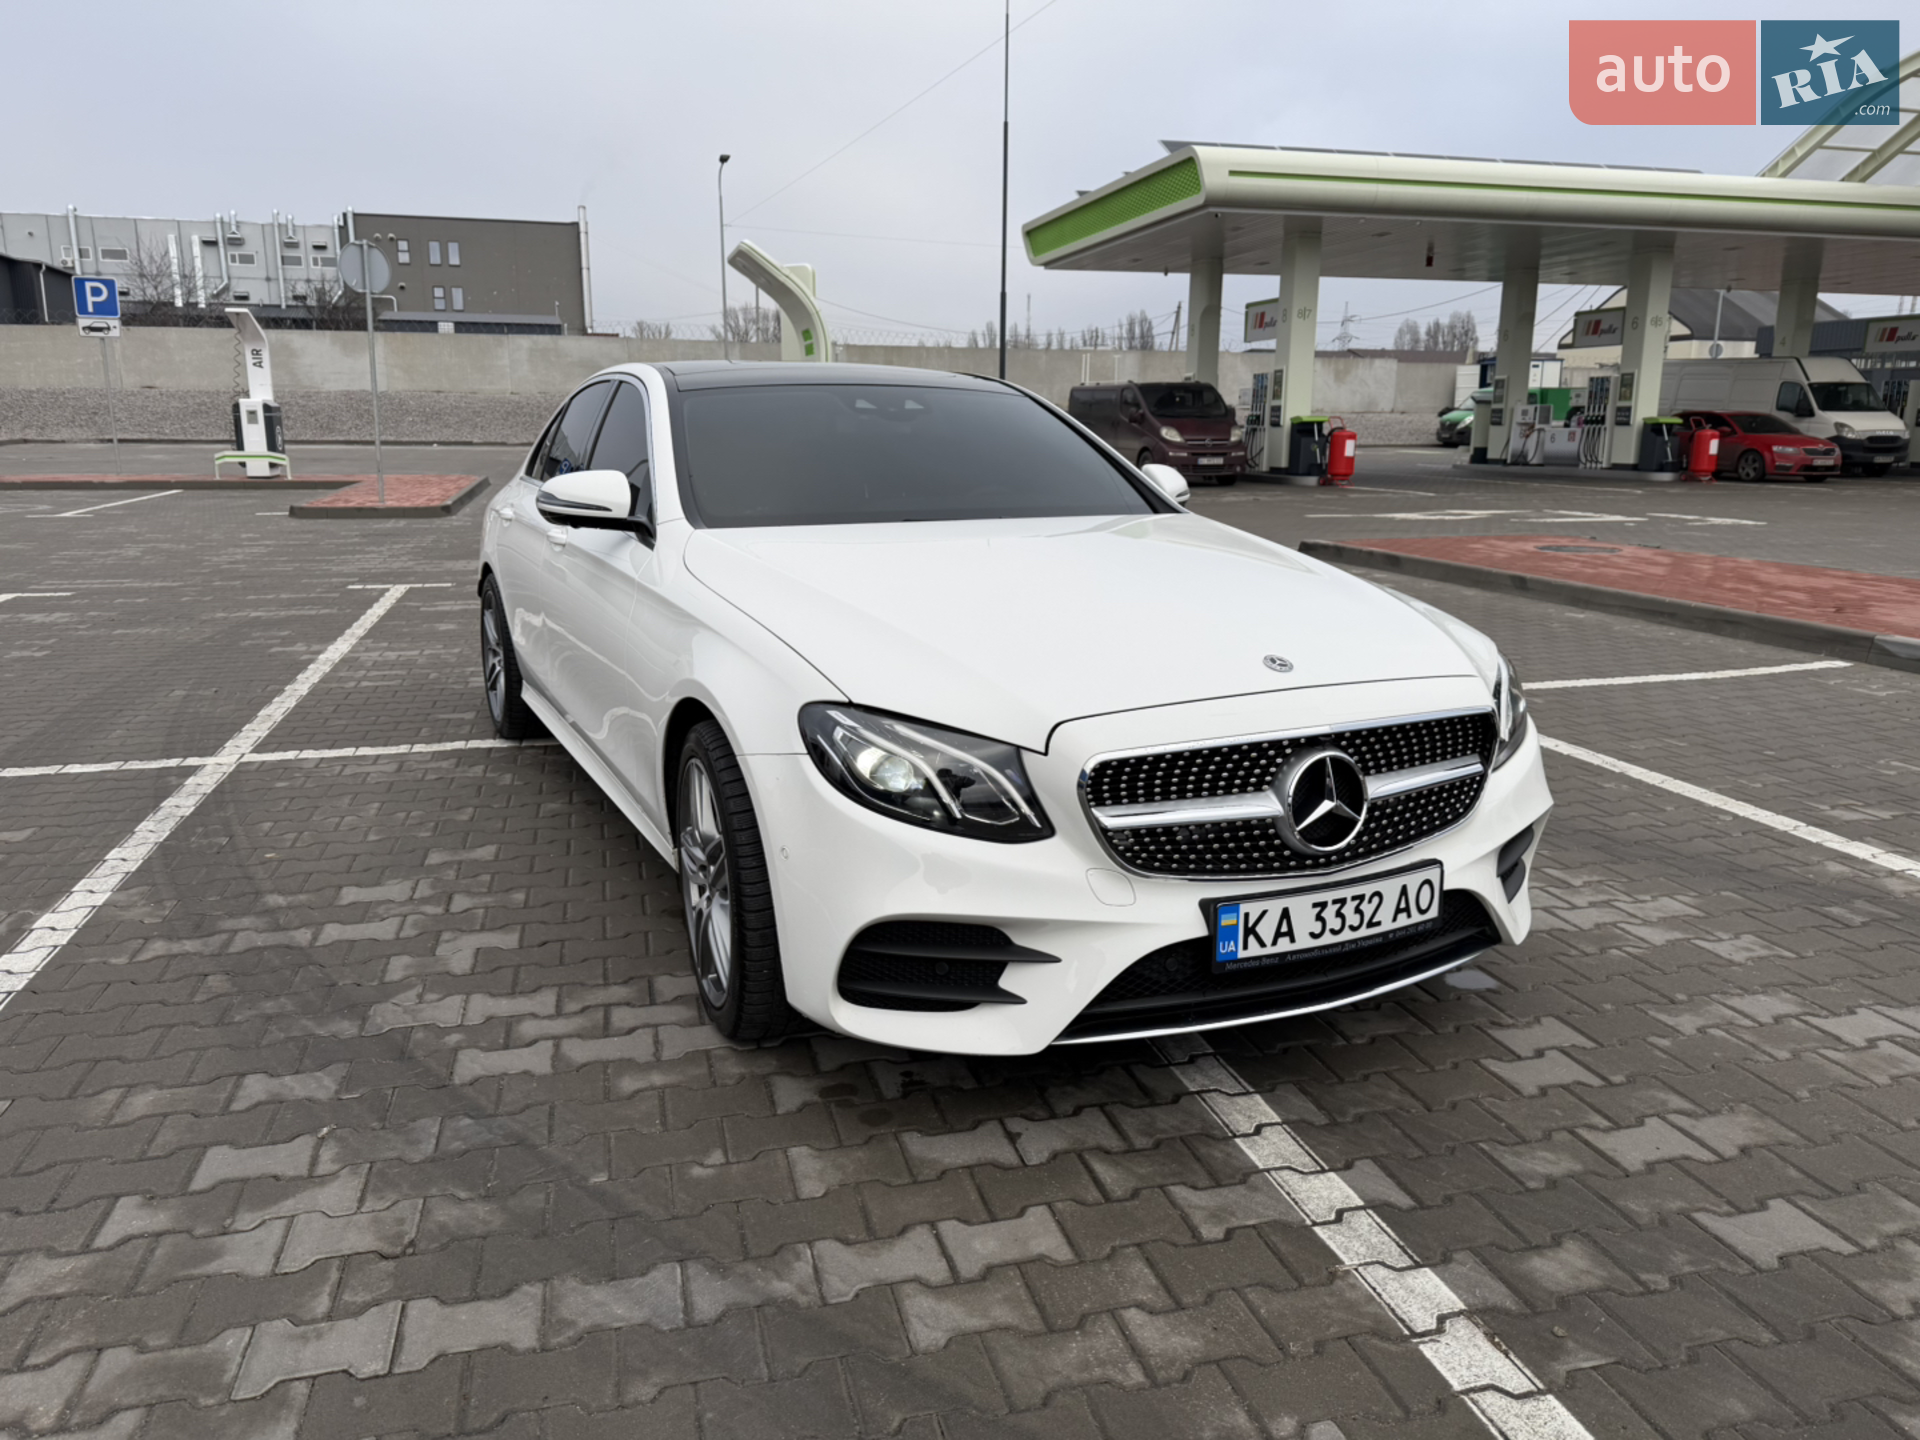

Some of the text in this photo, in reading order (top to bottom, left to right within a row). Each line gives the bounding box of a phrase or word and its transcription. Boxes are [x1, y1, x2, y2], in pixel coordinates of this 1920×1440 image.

[84, 281, 109, 313] P
[1631, 316, 1639, 330] 6
[250, 348, 265, 369] AIR
[1242, 878, 1435, 951] KA 3332 AO
[1219, 940, 1236, 953] UA
